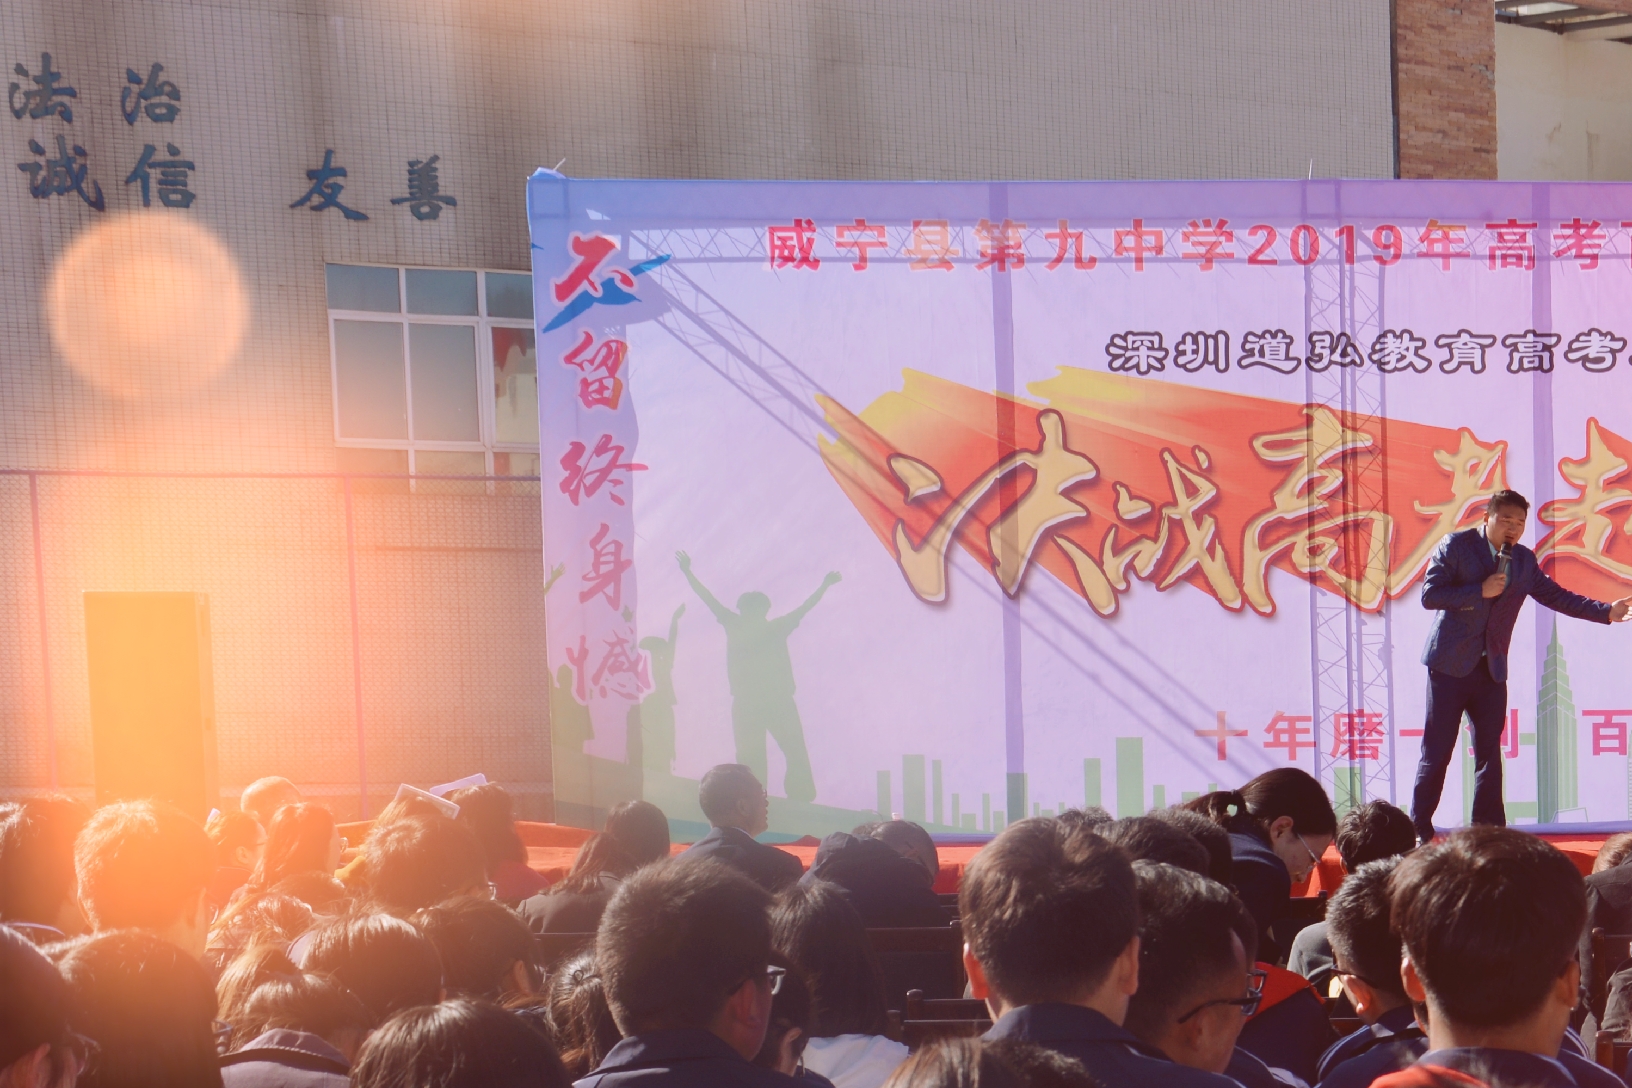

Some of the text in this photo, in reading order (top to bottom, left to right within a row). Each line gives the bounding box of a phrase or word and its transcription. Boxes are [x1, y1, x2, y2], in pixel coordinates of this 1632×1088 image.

[9, 52, 181, 126] 法治
[17, 134, 457, 221] 诚信 友善
[553, 233, 652, 701] 不留终身憾
